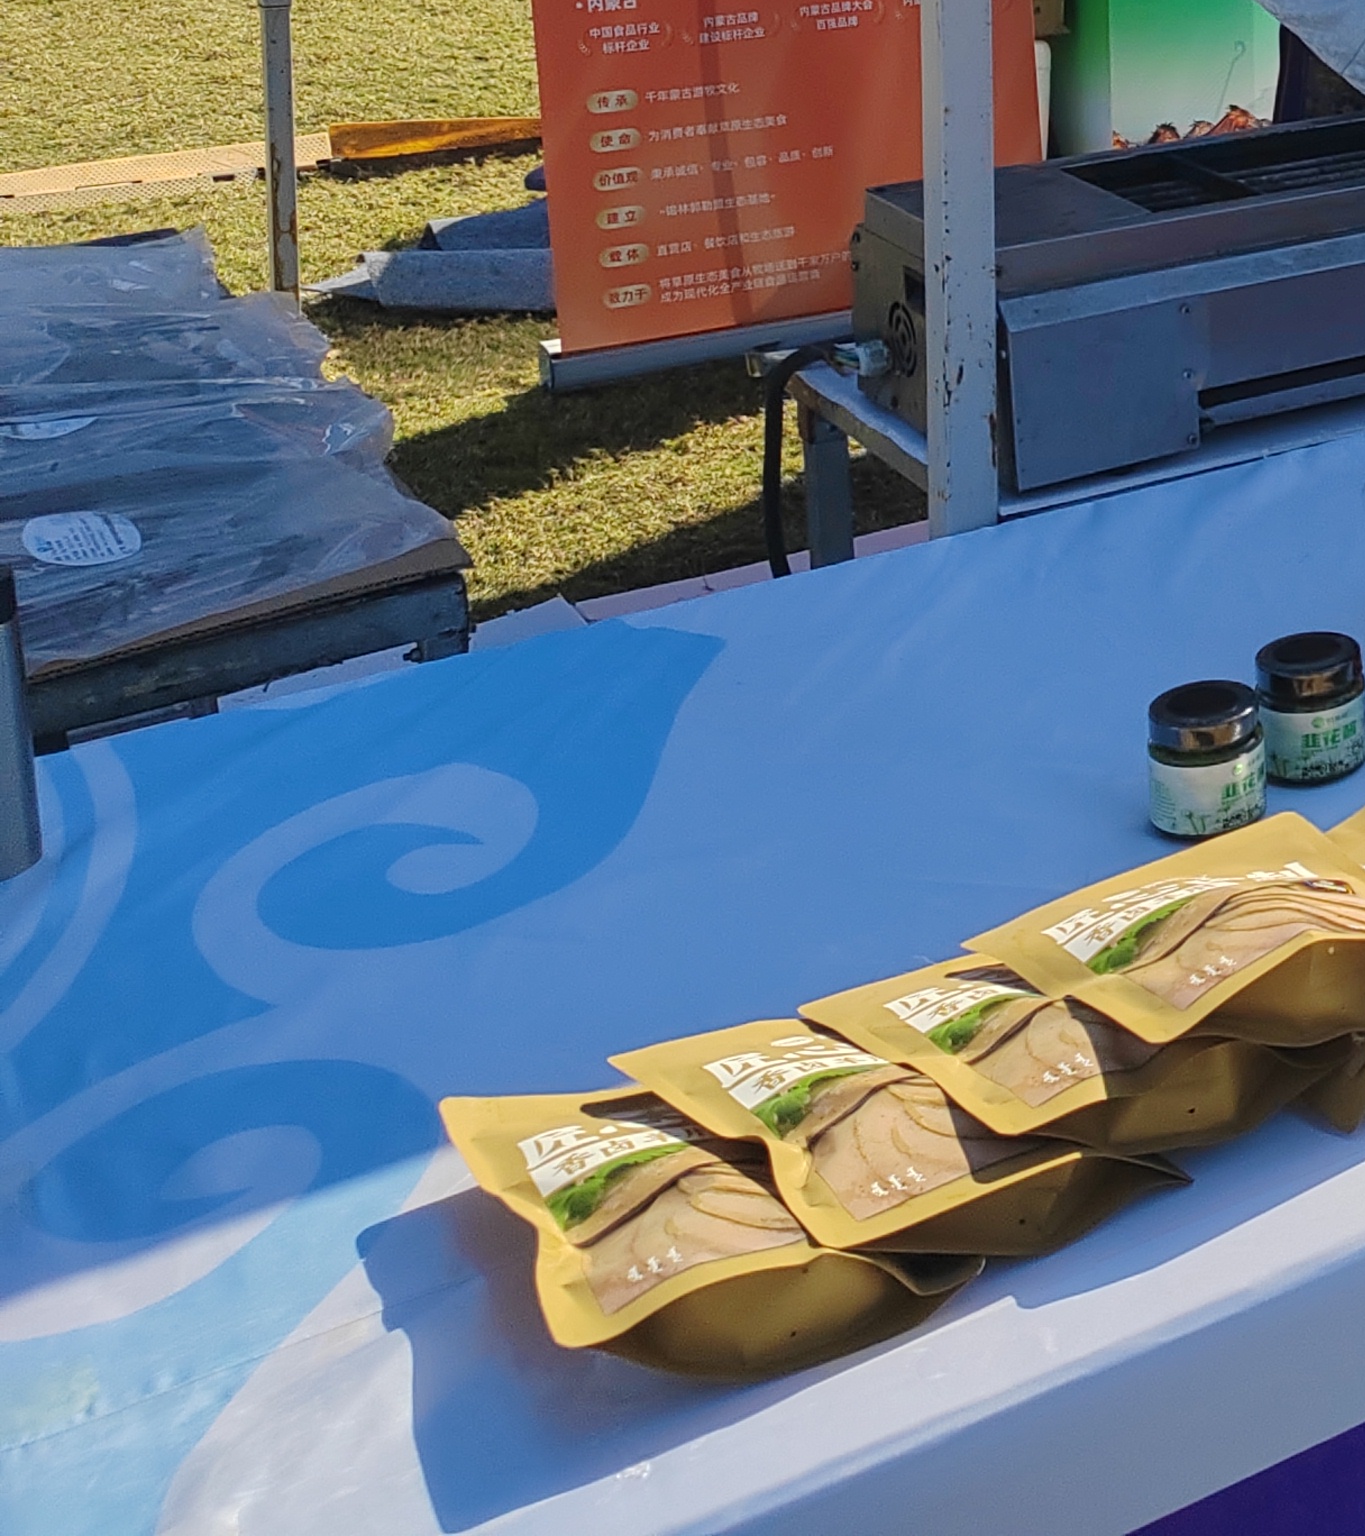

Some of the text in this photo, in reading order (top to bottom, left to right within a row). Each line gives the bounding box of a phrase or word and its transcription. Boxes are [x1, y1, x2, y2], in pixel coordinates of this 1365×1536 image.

[589, 21, 661, 39] 中国食品行业
[600, 132, 632, 148] 使命
[598, 168, 639, 186] 价值观
